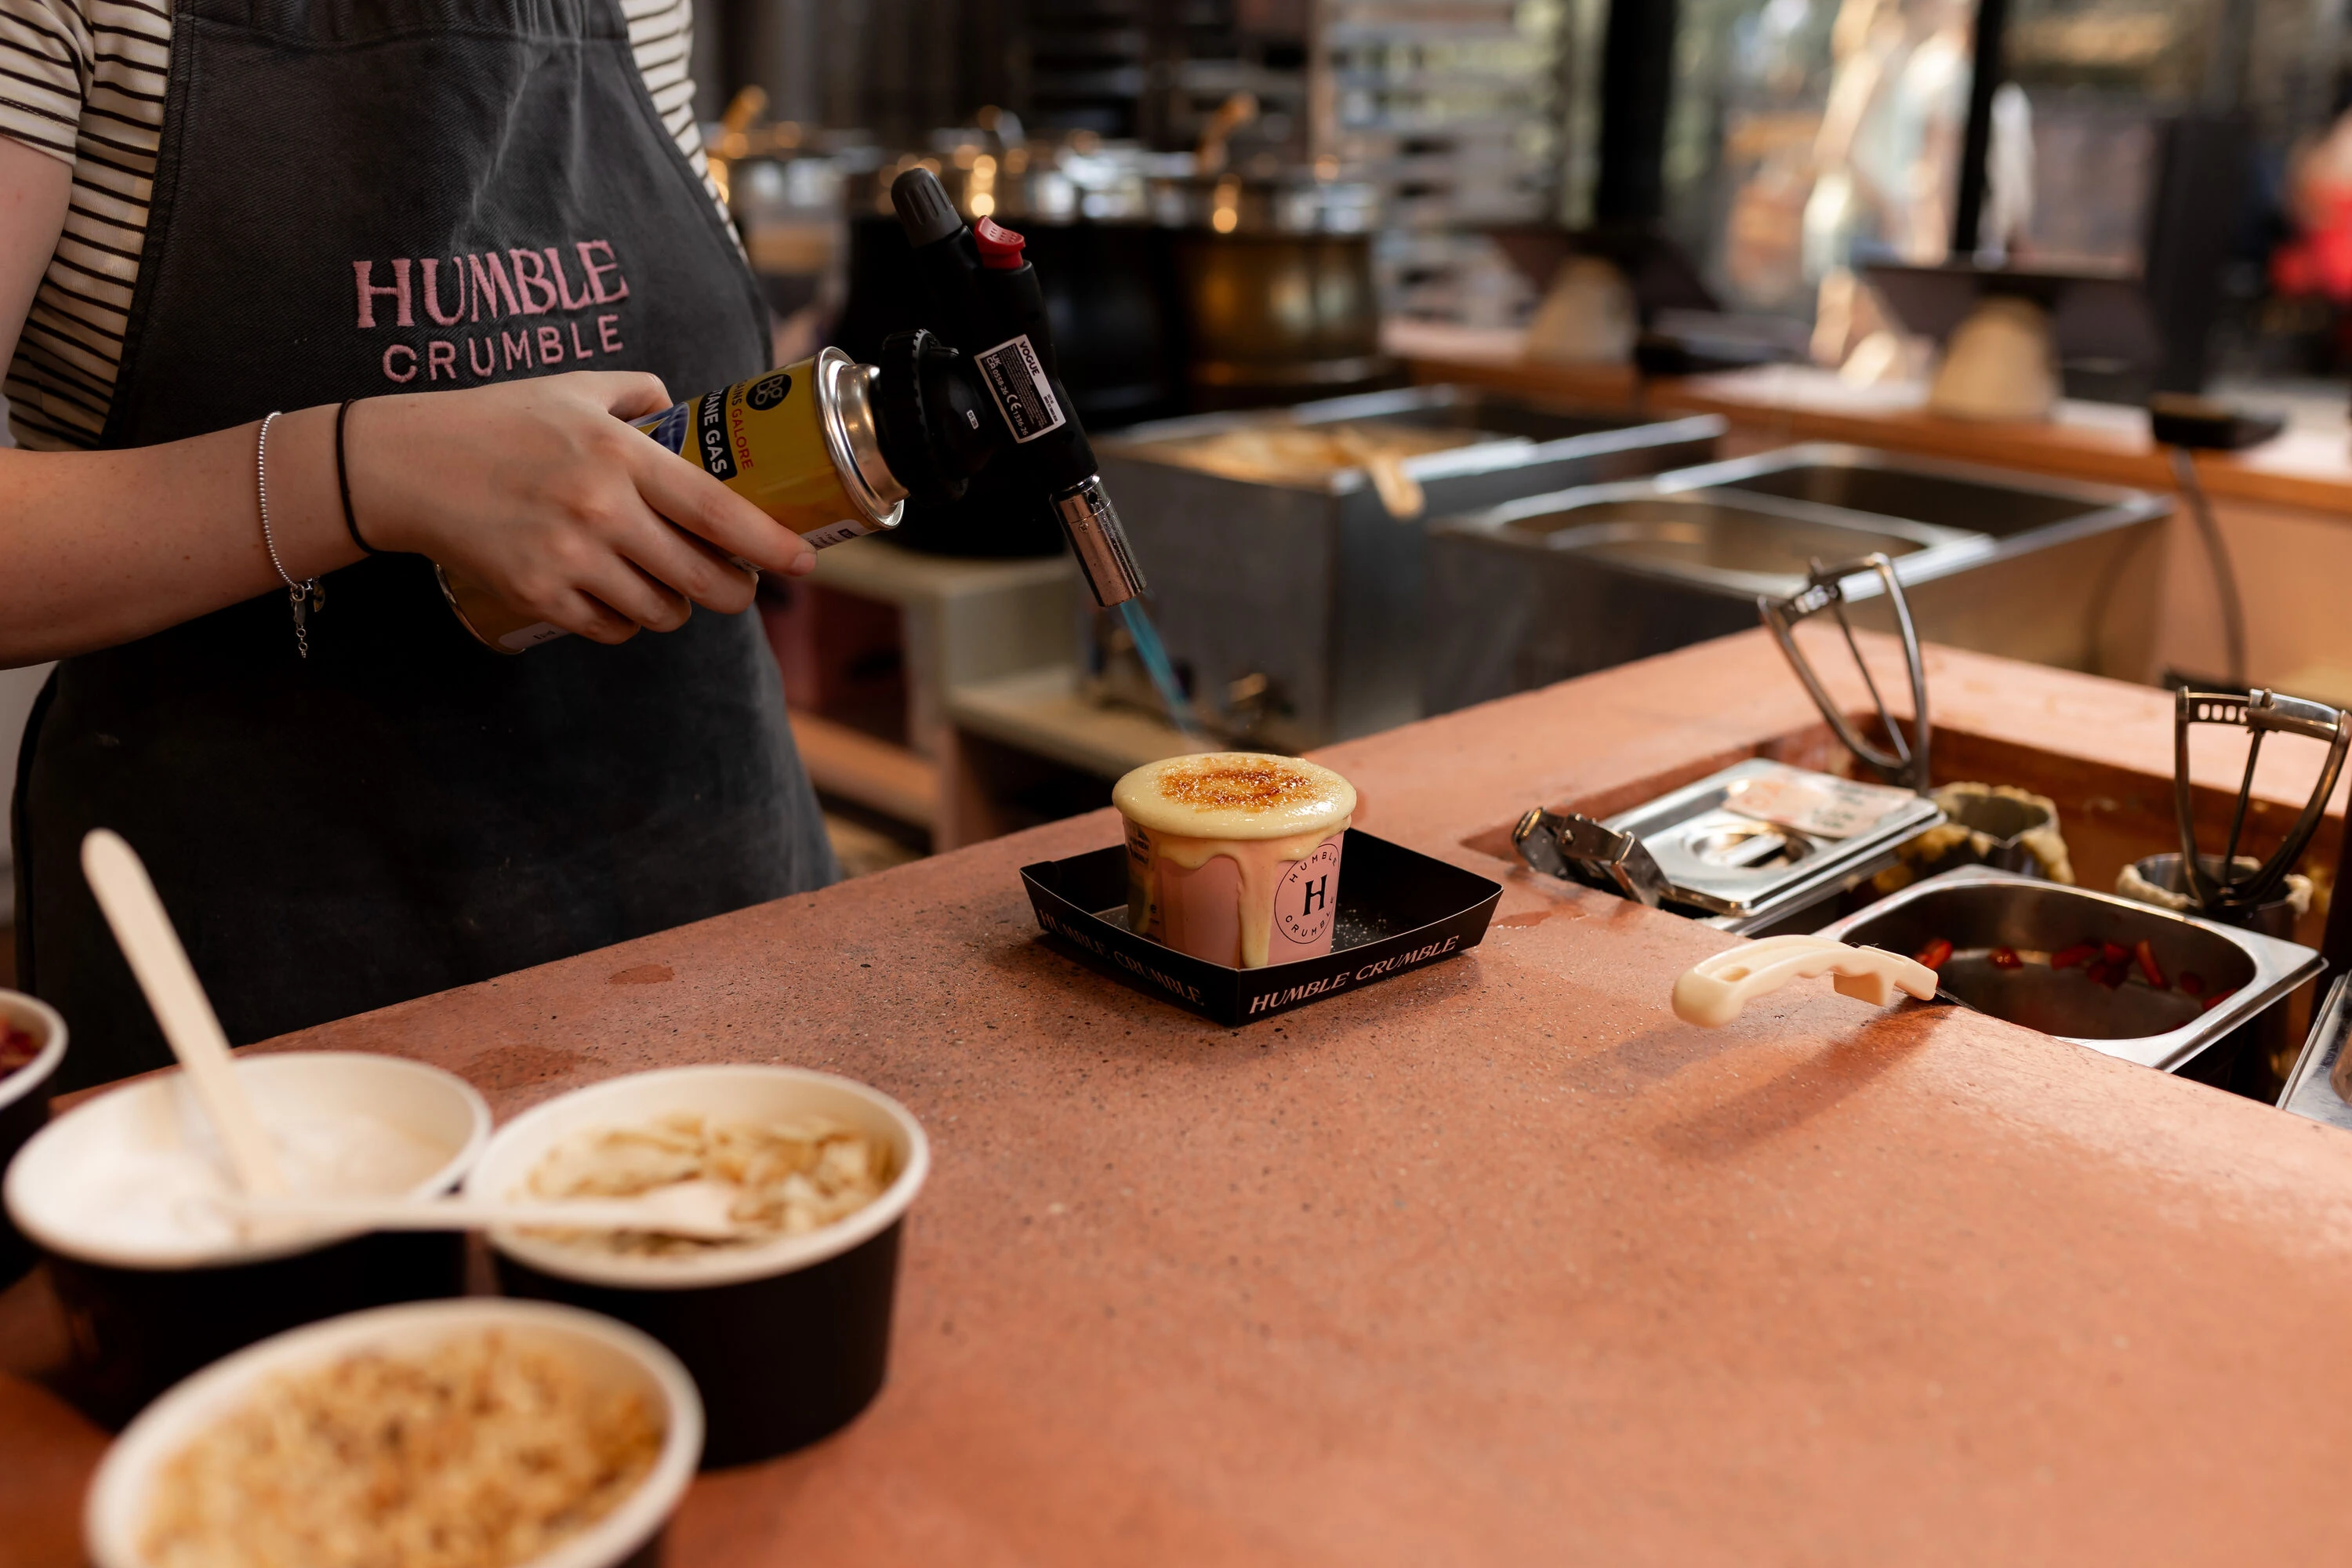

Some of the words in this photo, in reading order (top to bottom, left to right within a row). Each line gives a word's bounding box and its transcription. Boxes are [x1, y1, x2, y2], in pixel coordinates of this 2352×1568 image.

[353, 240, 629, 328] HUMBLE
[383, 314, 622, 383] CRUMBLE
[1019, 340, 1040, 376] VOGUE
[706, 429, 728, 474] GAS
[731, 408, 754, 470] GALORE
[1289, 851, 1337, 883] HUMBLE
[1302, 874, 1327, 916] H
[1039, 909, 1110, 960] HUMBLE
[1113, 950, 1205, 1007] CRUMBLE
[1248, 971, 1350, 1014] HUMBLE
[1355, 935, 1460, 981] CRUMBLE
